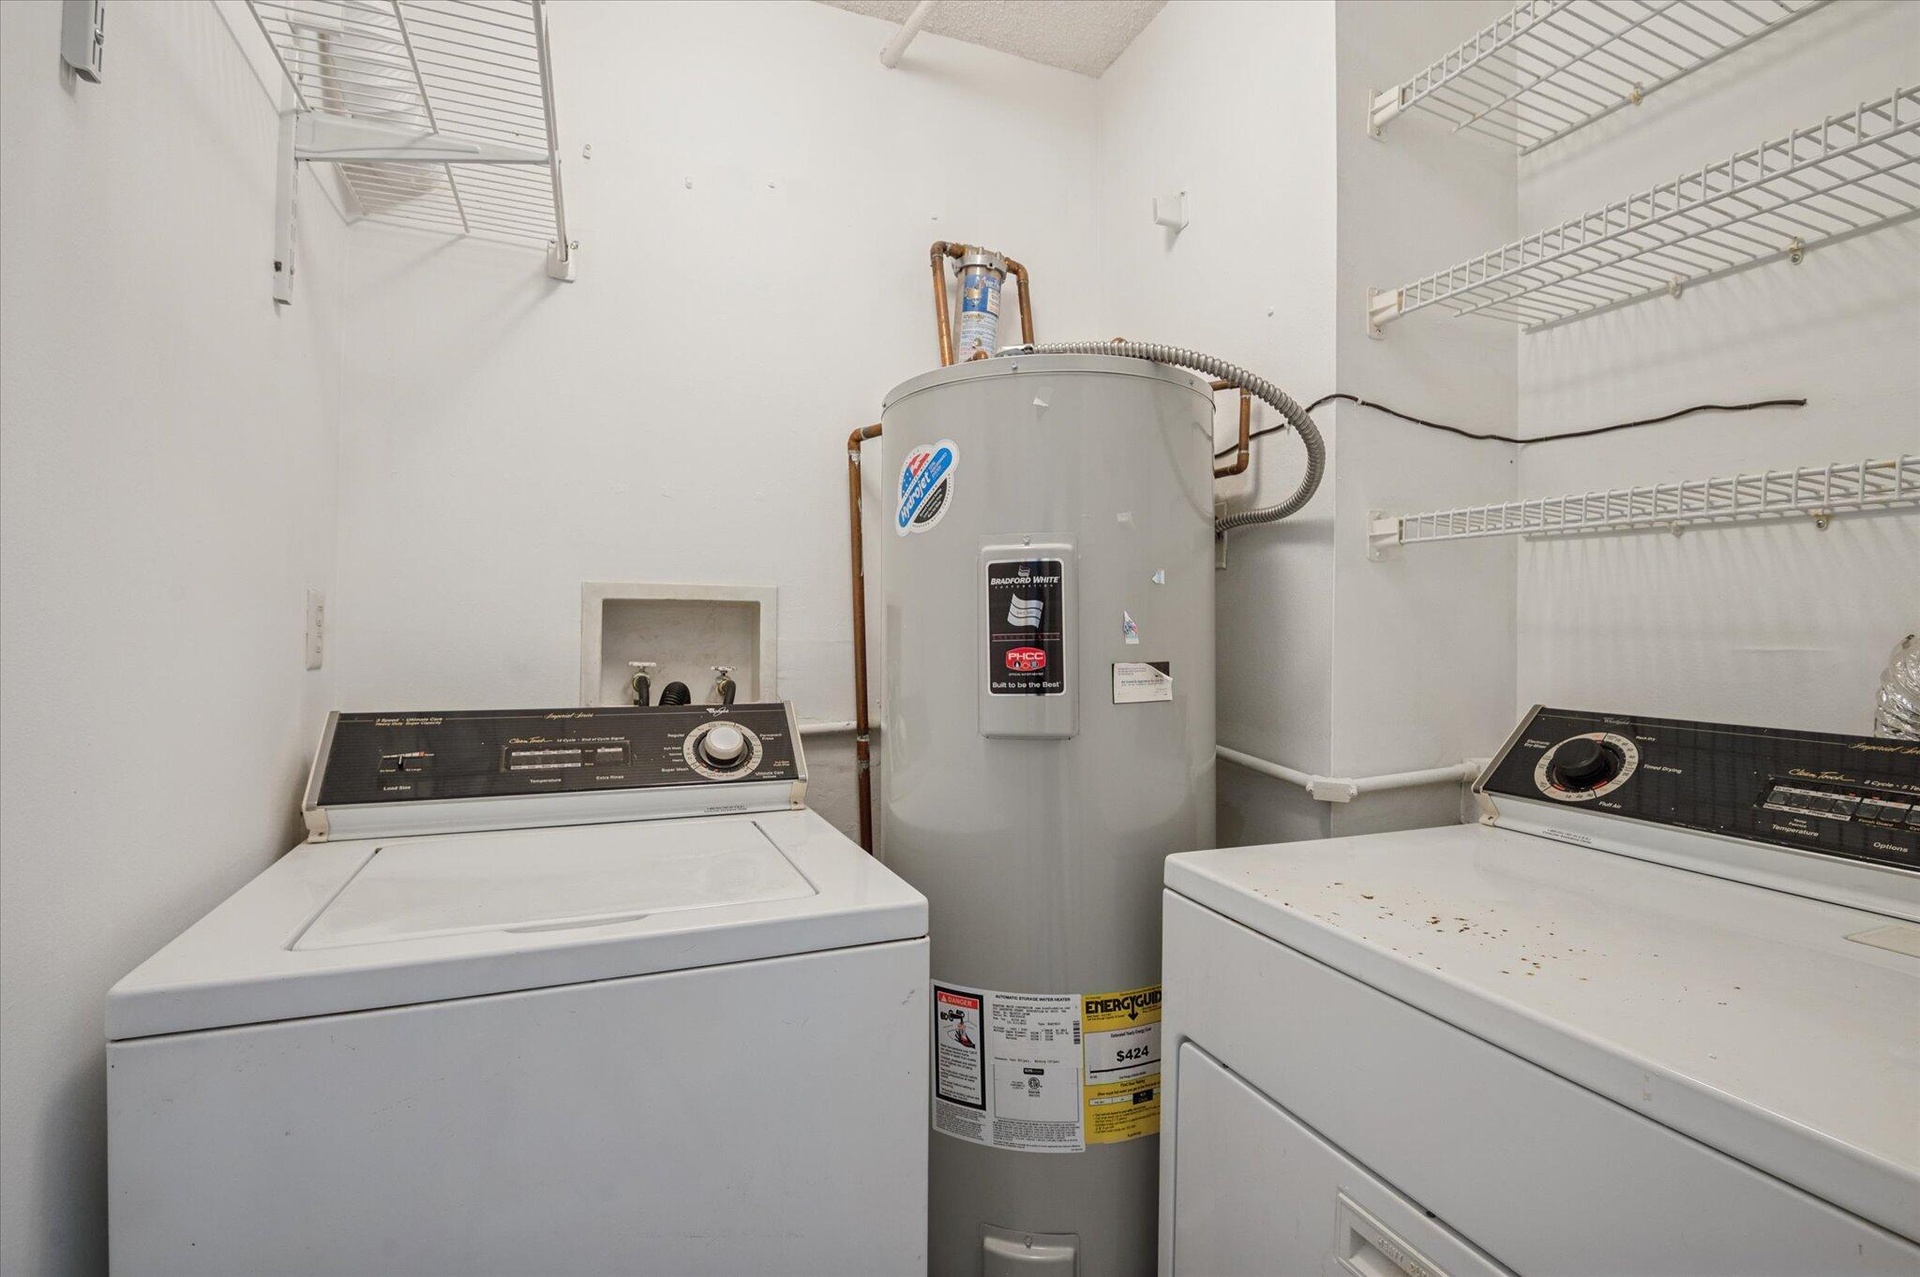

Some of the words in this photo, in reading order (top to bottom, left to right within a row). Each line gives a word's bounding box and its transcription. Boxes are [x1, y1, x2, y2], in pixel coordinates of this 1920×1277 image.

[900, 470, 931, 522] Hydrojet
[990, 576, 1031, 586] BRADFORD
[1033, 576, 1058, 584] WHITE
[1008, 652, 1044, 660] PHCC
[1772, 824, 1819, 837] Temperature
[1873, 841, 1908, 853] Options
[948, 996, 973, 1007] DANGER
[1086, 990, 1162, 1015] ENERGYGUID
[1117, 1045, 1149, 1062] $424
